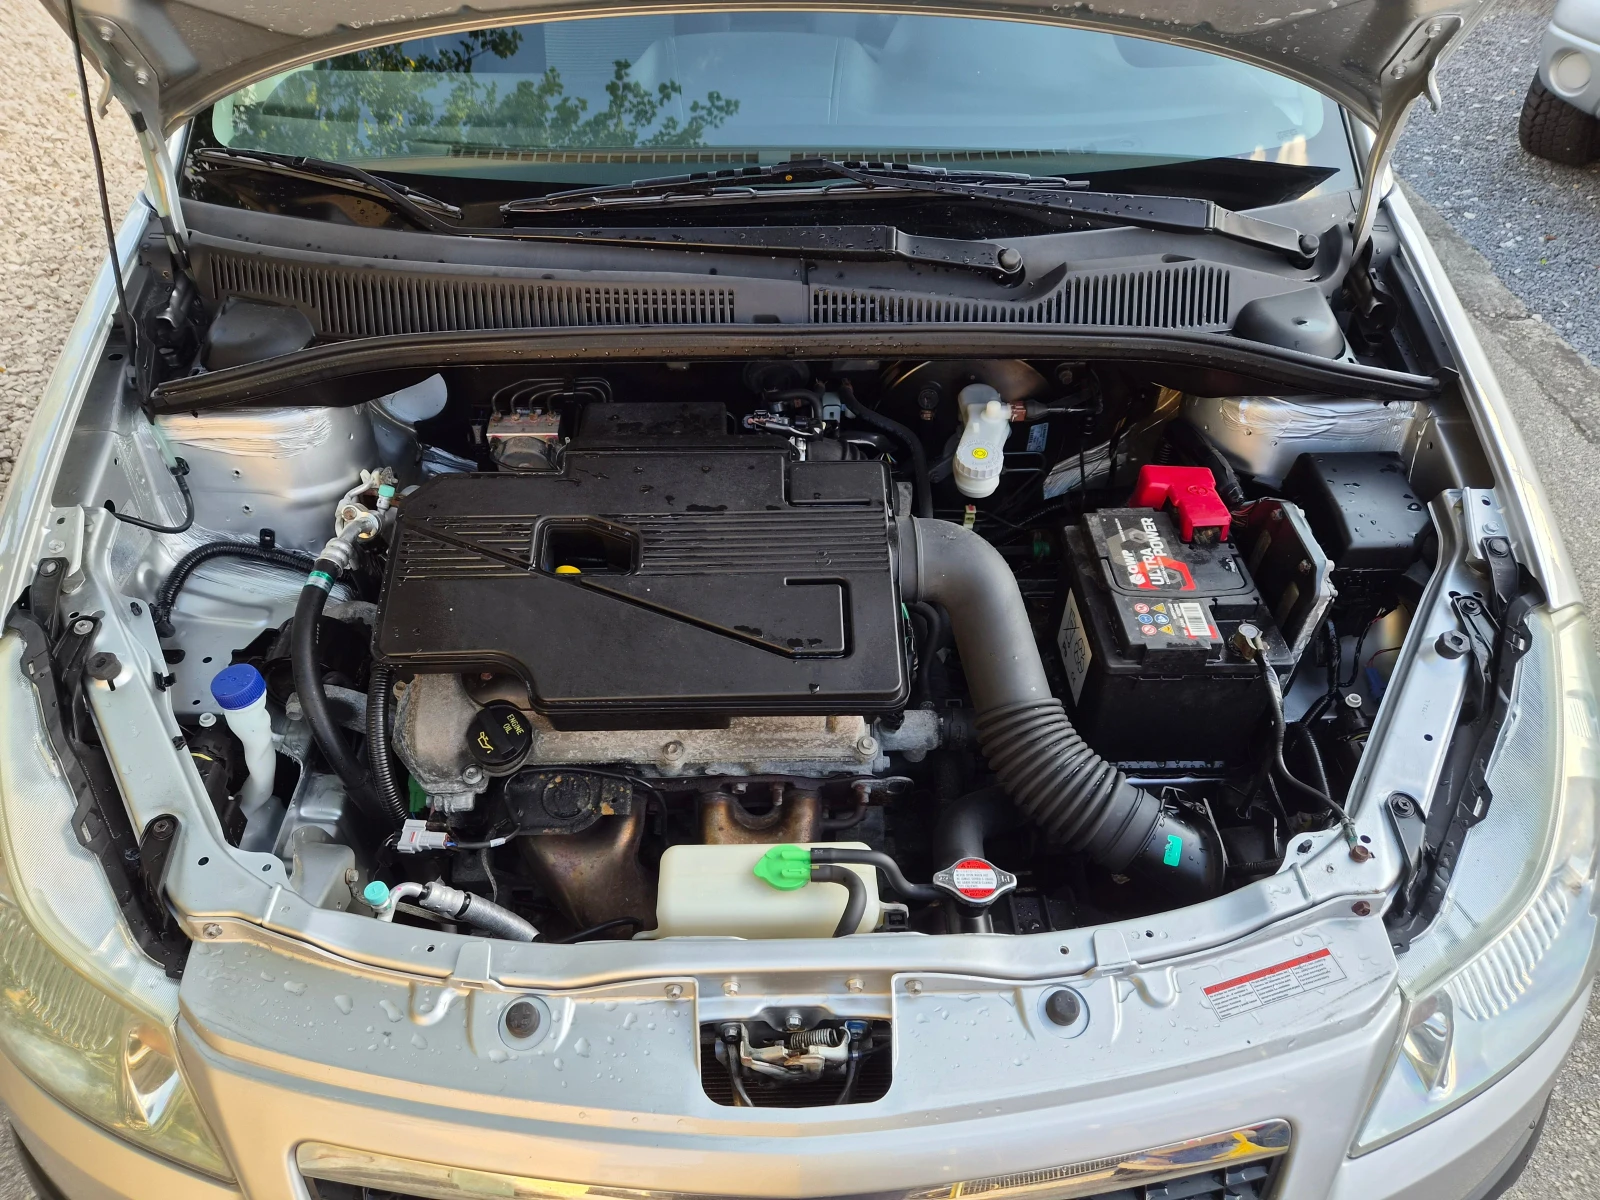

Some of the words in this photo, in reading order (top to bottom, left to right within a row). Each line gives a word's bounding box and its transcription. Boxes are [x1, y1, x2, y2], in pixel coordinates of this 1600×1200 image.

[1141, 517, 1167, 556] POWER
[1140, 547, 1165, 585] ULTRA
[503, 723, 512, 734] OIL
[507, 714, 524, 735] ENGINE
